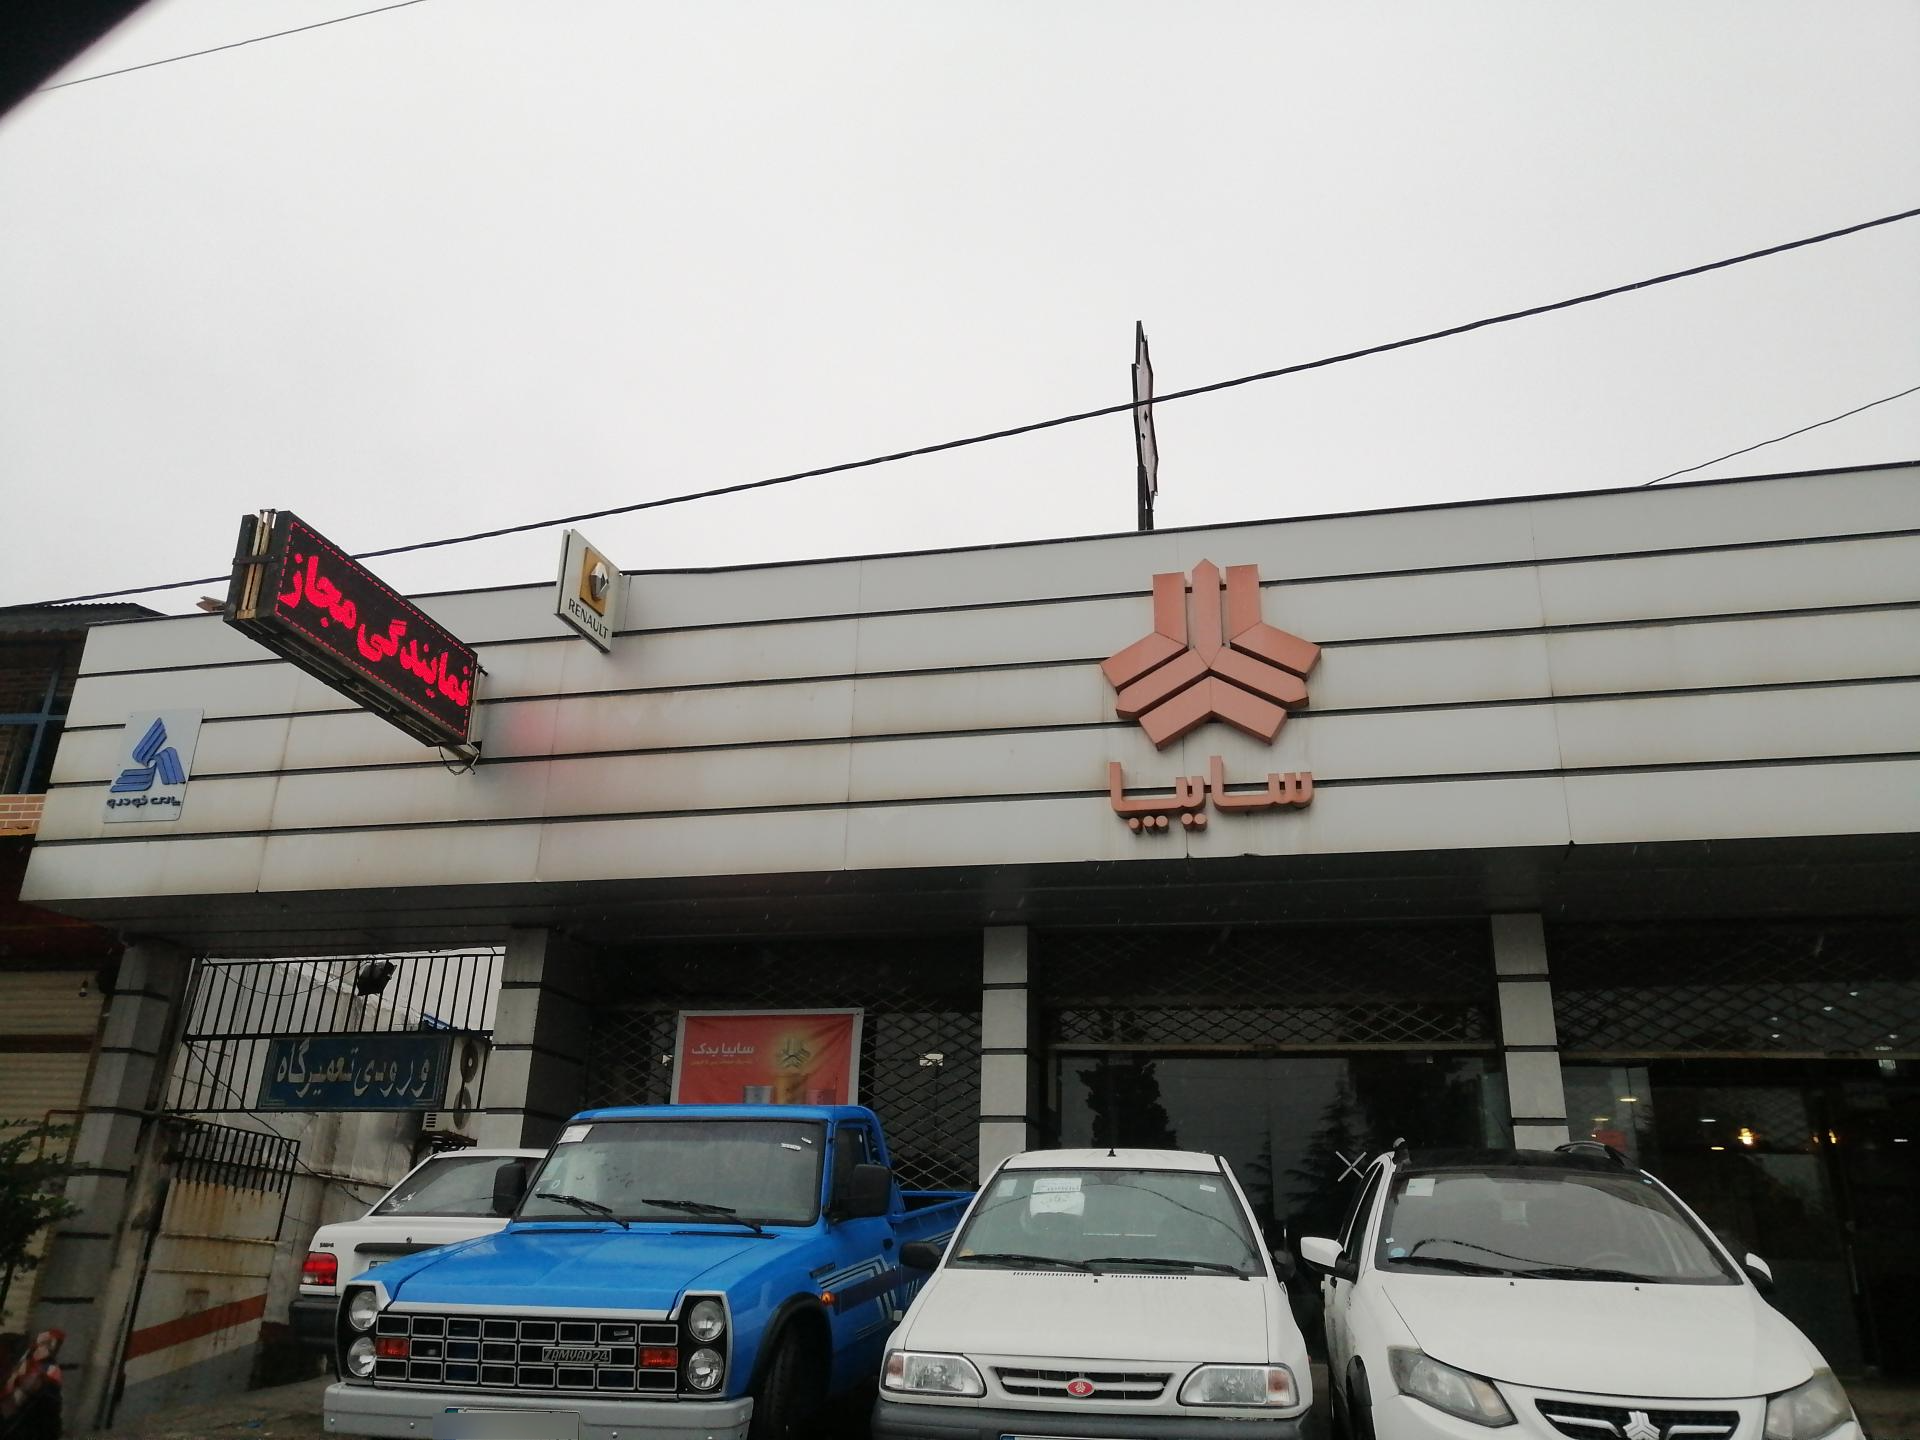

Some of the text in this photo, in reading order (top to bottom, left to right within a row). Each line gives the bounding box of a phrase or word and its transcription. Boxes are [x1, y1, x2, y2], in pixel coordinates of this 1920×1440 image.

[279, 553, 469, 706] نمایندگی مجاز
[568, 598, 609, 639] RENAULT
[1109, 755, 1314, 834] سایپا
[276, 1038, 431, 1098] ورودی تعمیرگاه
[691, 1042, 754, 1057] سایپا یدک
